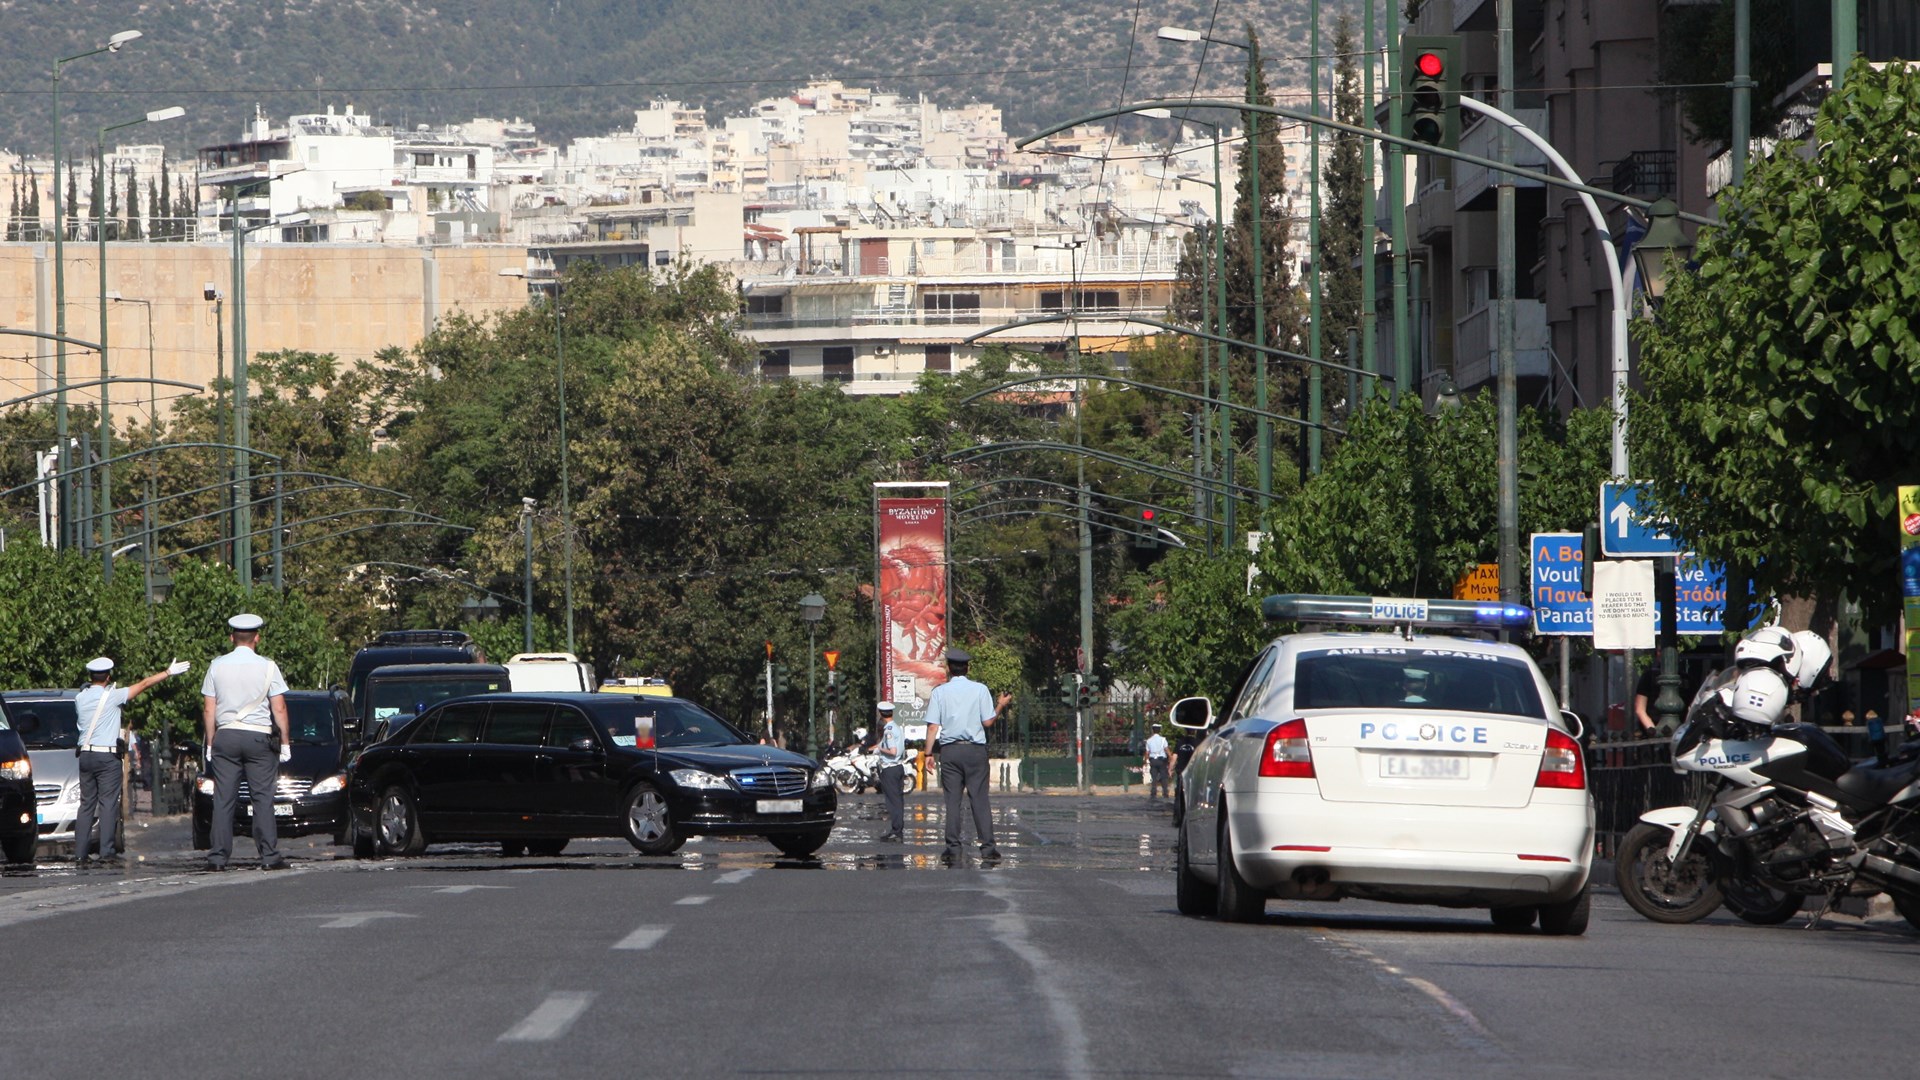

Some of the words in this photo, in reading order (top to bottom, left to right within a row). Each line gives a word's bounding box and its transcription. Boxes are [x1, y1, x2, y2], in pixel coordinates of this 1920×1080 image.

[1374, 603, 1425, 619] POLICE
[1421, 650, 1498, 662] ΔΡΑΣΗ
[1699, 753, 1751, 767] POLICE
